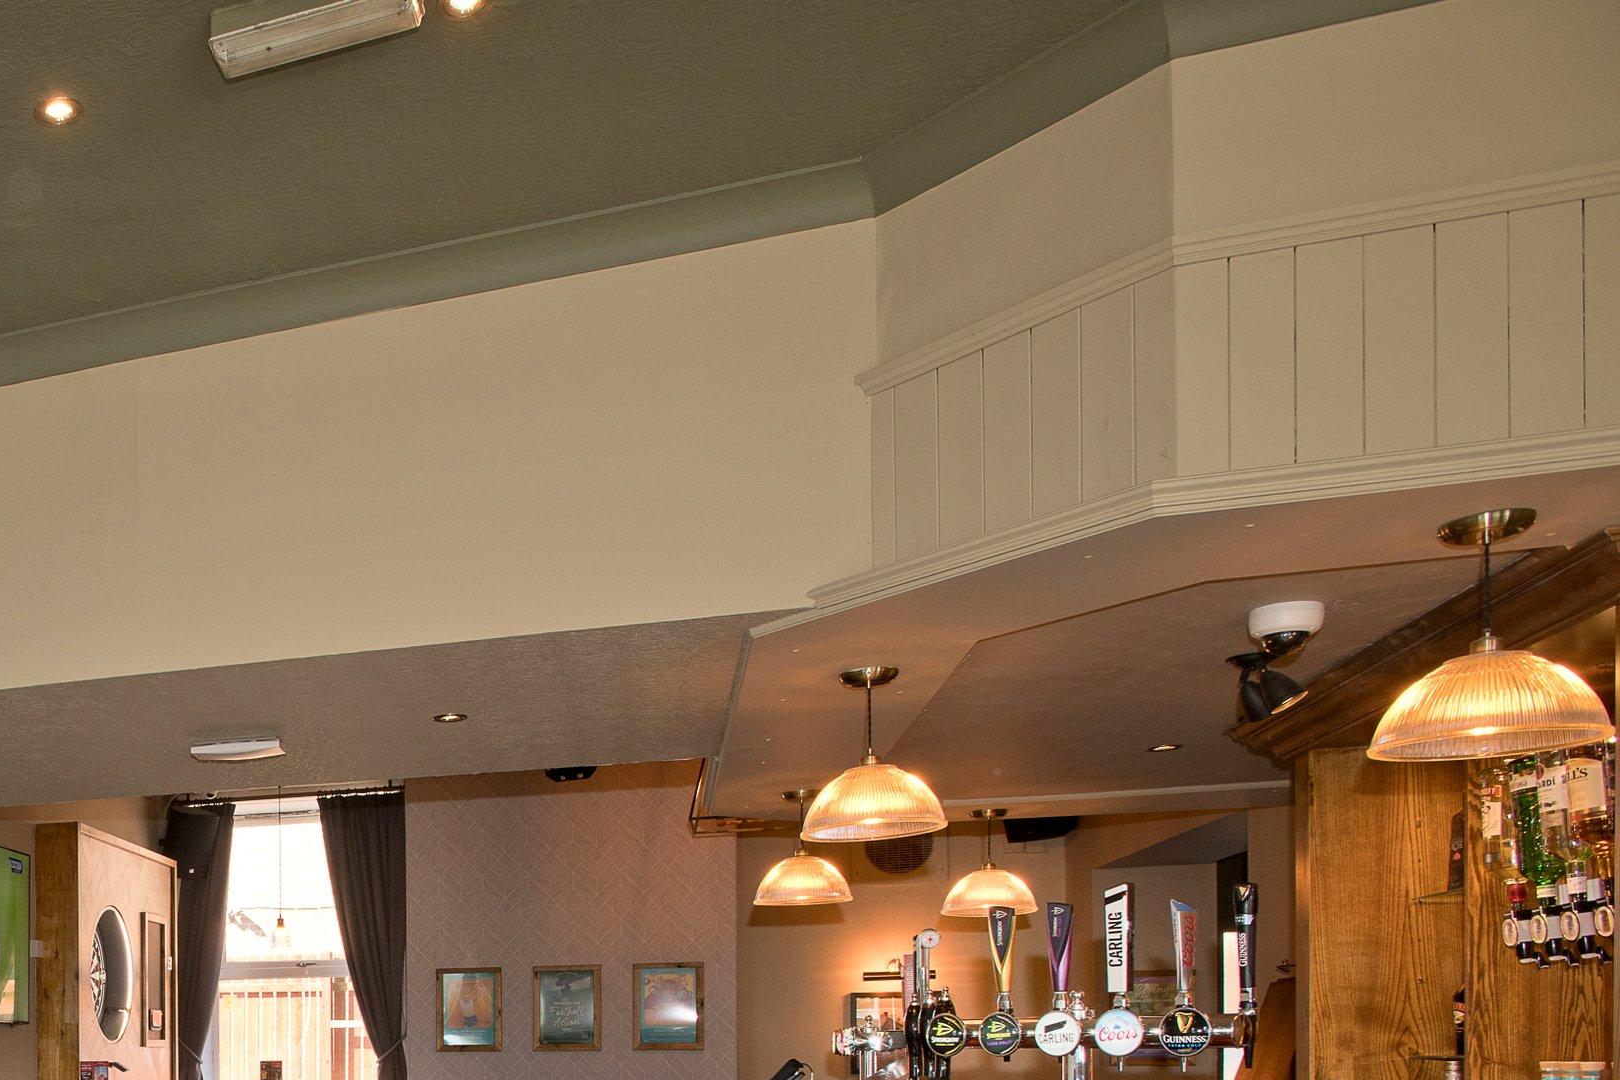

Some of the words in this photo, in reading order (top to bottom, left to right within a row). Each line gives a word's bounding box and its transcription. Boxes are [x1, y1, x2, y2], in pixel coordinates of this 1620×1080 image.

[1108, 911, 1122, 968] CARLING
[1182, 914, 1196, 967] Coors
[1239, 932, 1248, 967] GUINNESS
[1039, 1033, 1075, 1044] CARLING
[1098, 1026, 1138, 1042] Coors
[1162, 1034, 1207, 1044] GUINNESS
